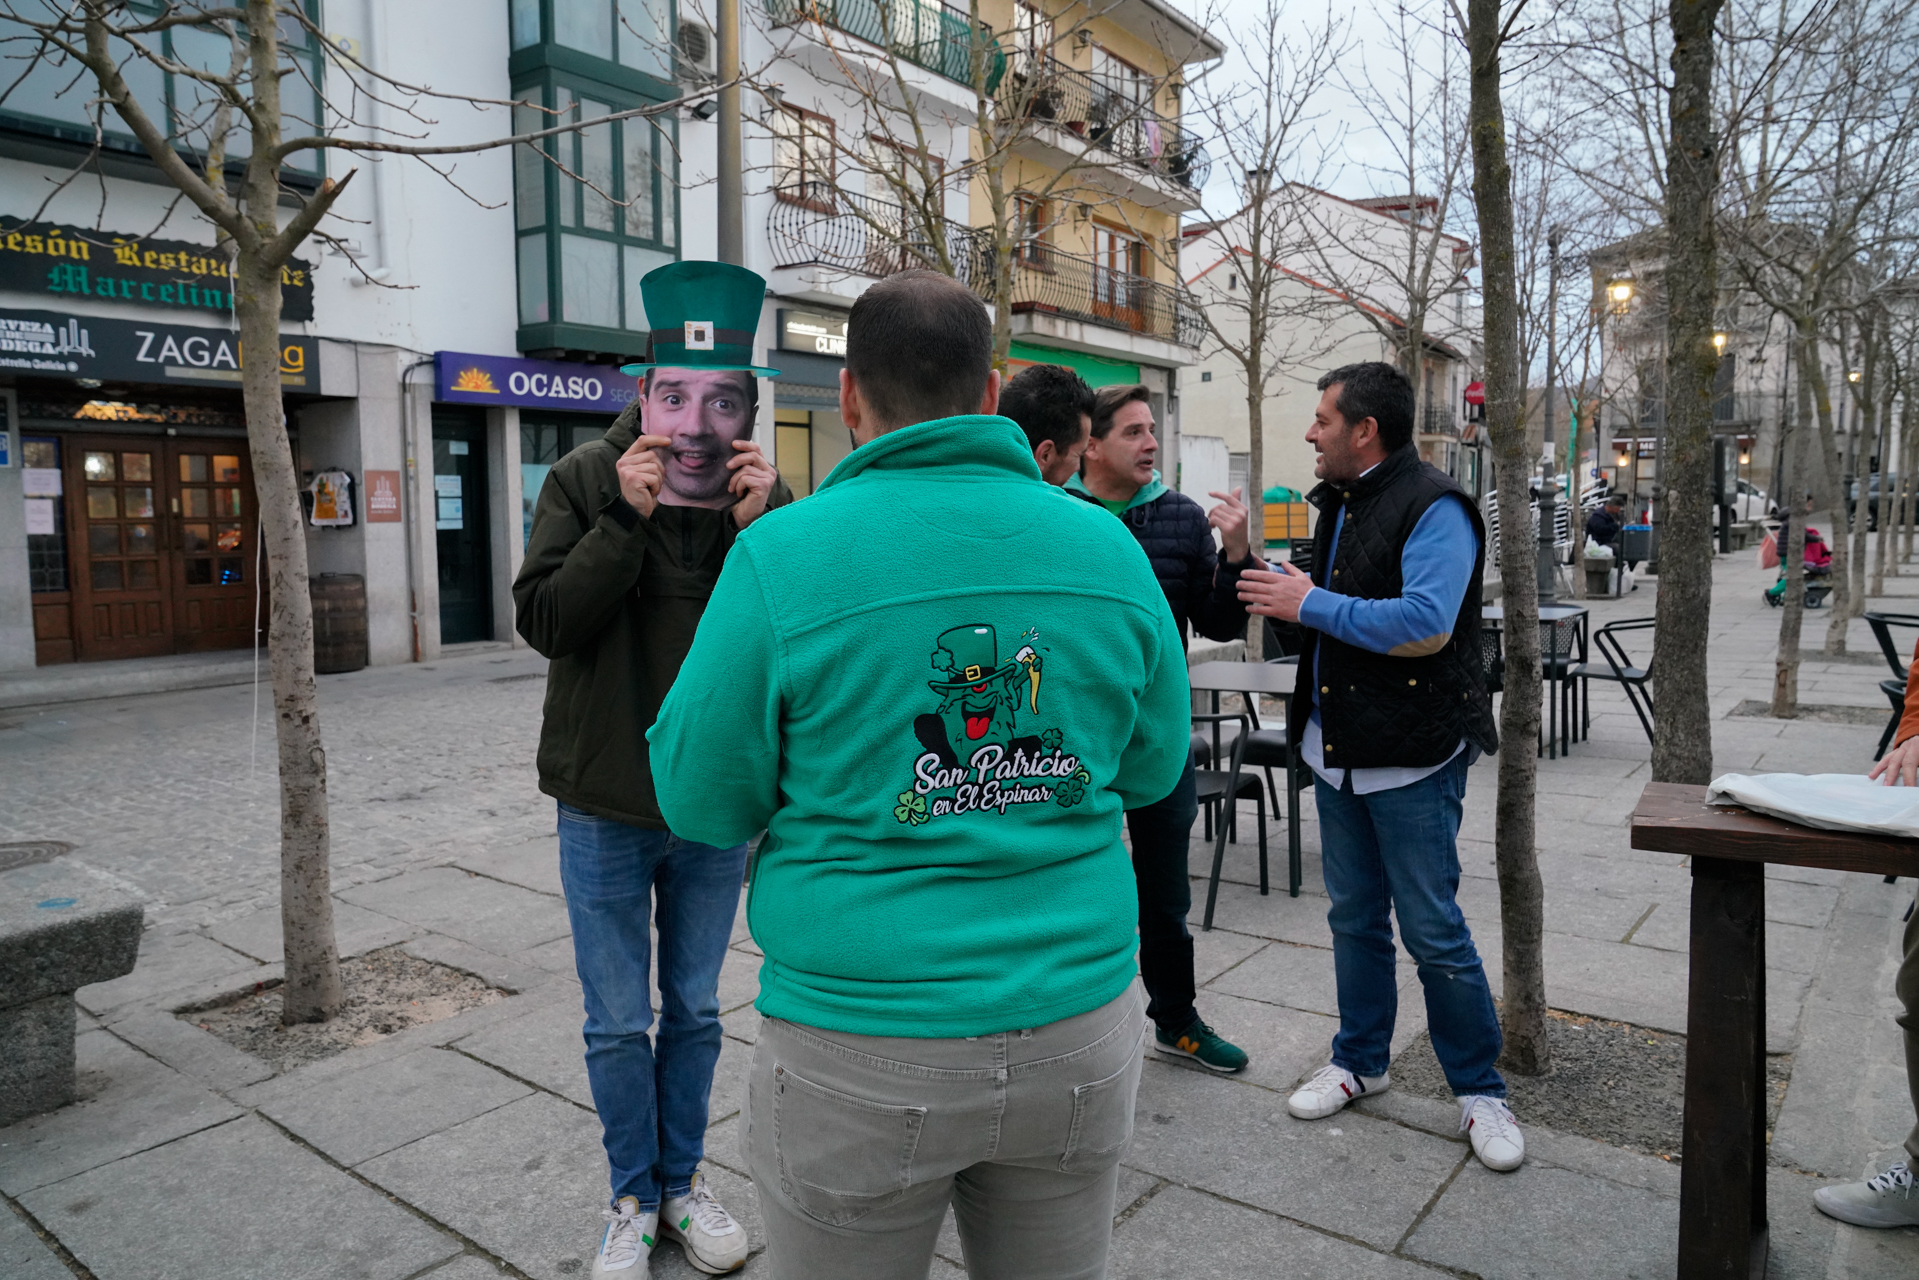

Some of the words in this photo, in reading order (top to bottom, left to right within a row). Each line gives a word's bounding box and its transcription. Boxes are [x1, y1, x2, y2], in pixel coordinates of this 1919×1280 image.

[0, 222, 90, 260] esón
[112, 238, 305, 287] Restaute
[0, 339, 59, 355] DEGA
[509, 371, 603, 400] OCASO
[914, 753, 968, 794] San
[970, 745, 1079, 785] Patricio
[932, 800, 952, 816] en
[953, 784, 978, 815] El
[979, 783, 1053, 815] Espinar
